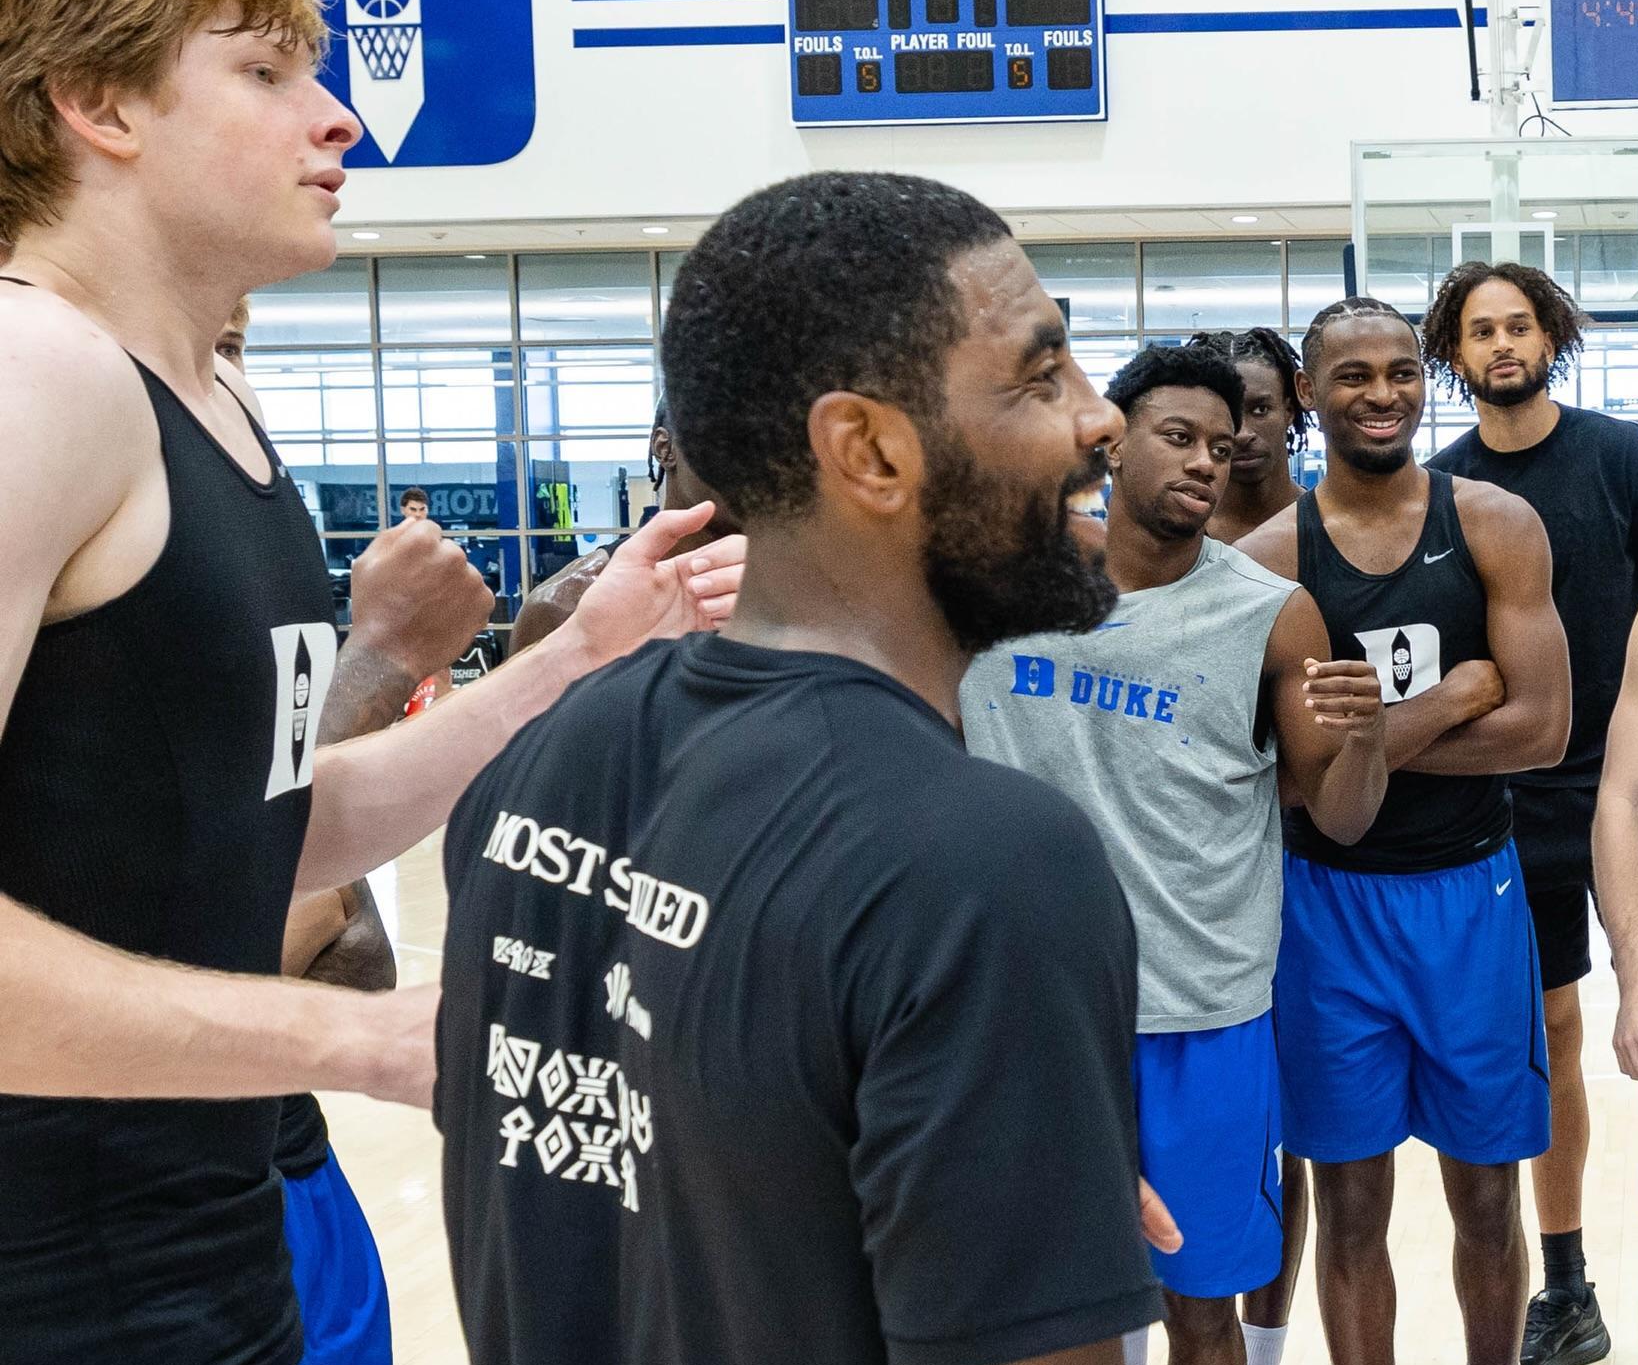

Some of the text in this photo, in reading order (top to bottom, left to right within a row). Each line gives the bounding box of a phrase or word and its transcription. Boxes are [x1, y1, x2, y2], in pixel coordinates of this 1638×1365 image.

[794, 36, 843, 53] FOULS
[890, 31, 996, 51] PLAYER FOUL
[1043, 29, 1093, 48] FOULS
[853, 46, 883, 60] T.O.L.
[1005, 43, 1034, 57] T.O.L.
[861, 64, 877, 91] 5
[1013, 60, 1029, 87] 5
[1070, 670, 1179, 724] DUKE
[482, 810, 607, 896] MOST
